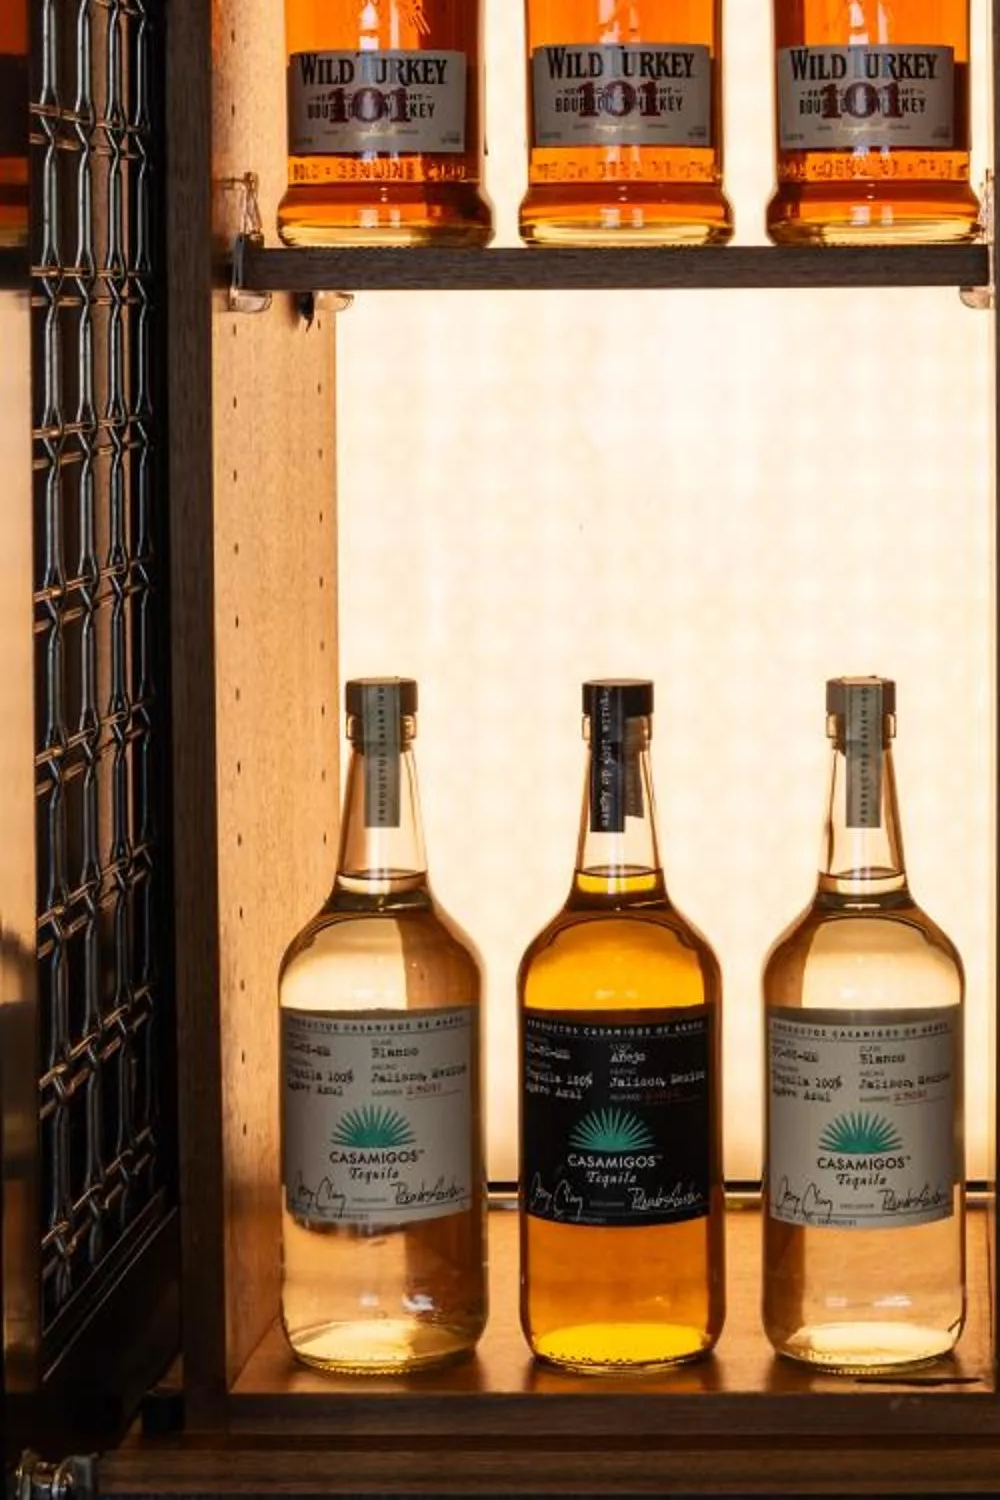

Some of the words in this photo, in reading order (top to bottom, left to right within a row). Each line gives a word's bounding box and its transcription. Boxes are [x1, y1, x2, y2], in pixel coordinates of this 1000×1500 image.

[299, 53, 355, 87] WILD
[356, 52, 447, 87] TURKEY
[546, 46, 604, 80] WILD
[606, 45, 695, 81] TURKEY
[790, 49, 847, 81] WILD
[847, 47, 938, 82] TURKEY
[328, 87, 412, 123] 101
[555, 97, 614, 113] BOURON
[579, 81, 660, 117] 101
[799, 98, 857, 115] BOUO
[820, 82, 904, 118] 101
[307, 102, 366, 119] BOUO
[329, 1151, 418, 1164] CASAMIGOS
[568, 1155, 656, 1168] CASAMIGOS
[817, 1157, 905, 1170] CASAMIGOS
[349, 1167, 400, 1183] Tequila
[586, 1171, 637, 1188] Tequila
[836, 1173, 888, 1190] Tequila
